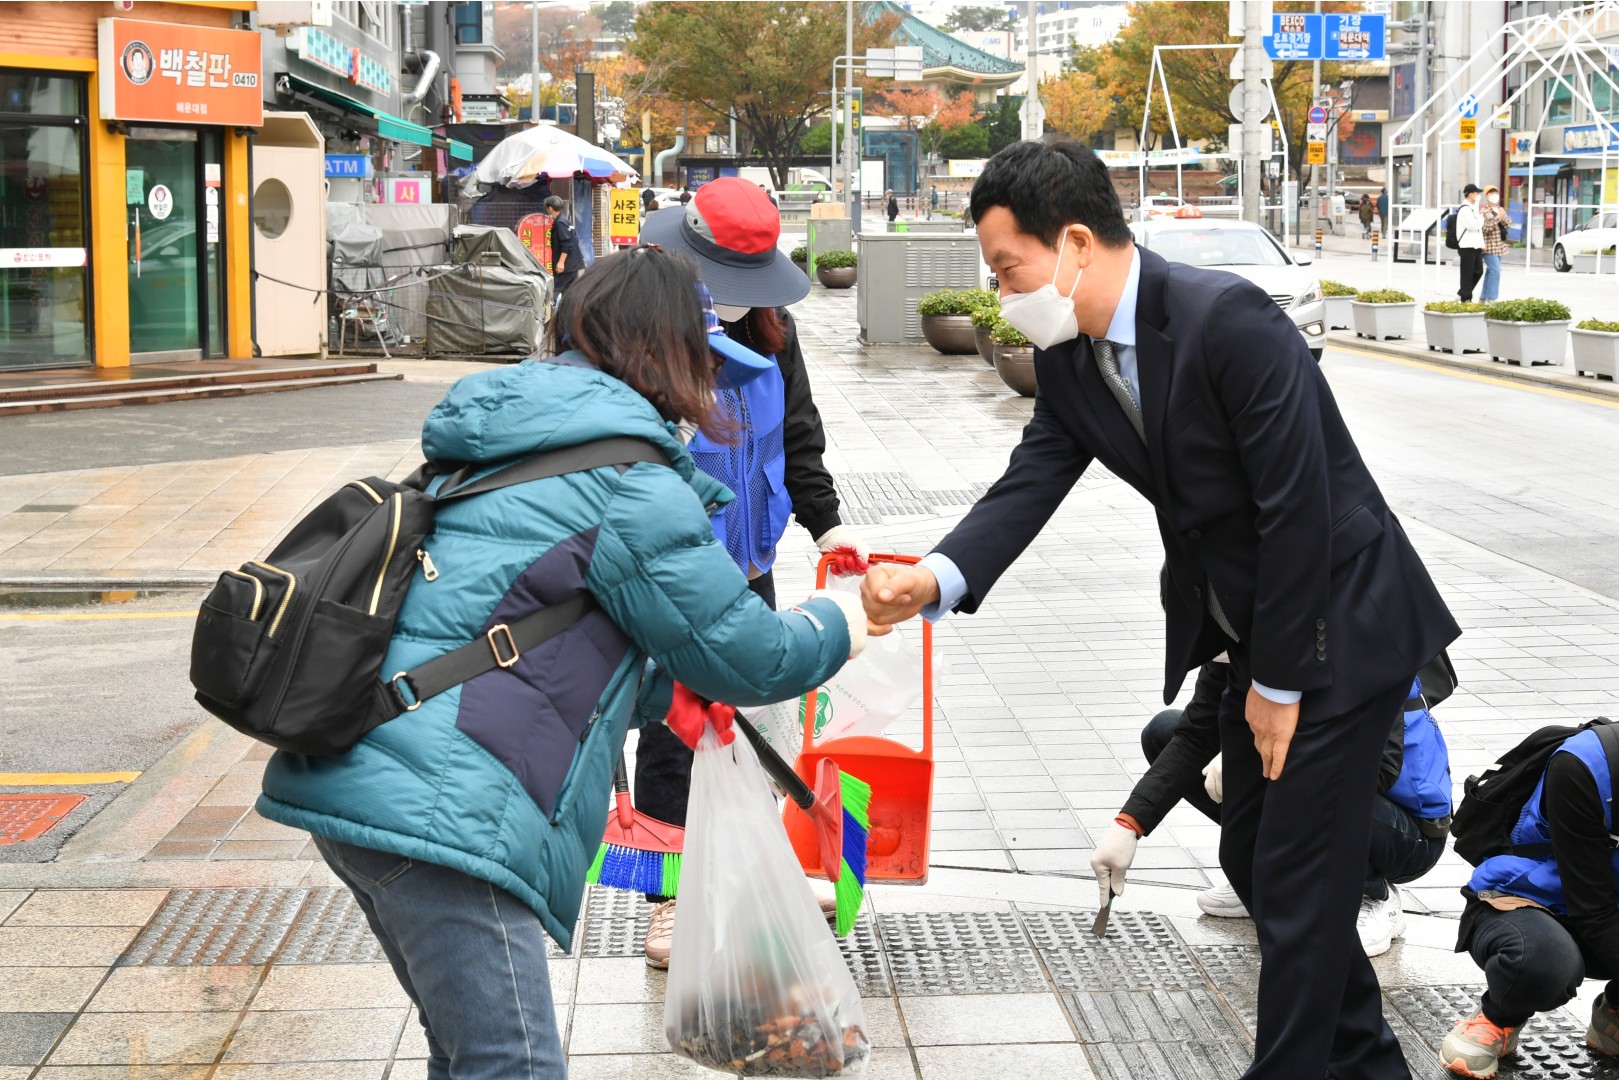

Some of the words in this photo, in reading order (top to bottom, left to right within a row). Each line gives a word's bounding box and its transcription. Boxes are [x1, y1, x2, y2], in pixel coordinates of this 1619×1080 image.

[1281, 15, 1305, 26] BEXCO
[159, 48, 232, 89] 백철판
[234, 73, 256, 86] 0410
[176, 101, 208, 115] 해운대점
[852, 117, 859, 129] 5
[324, 159, 358, 174] ATM
[400, 186, 415, 201] 사
[613, 199, 637, 211] 사주
[613, 213, 637, 225] 타로
